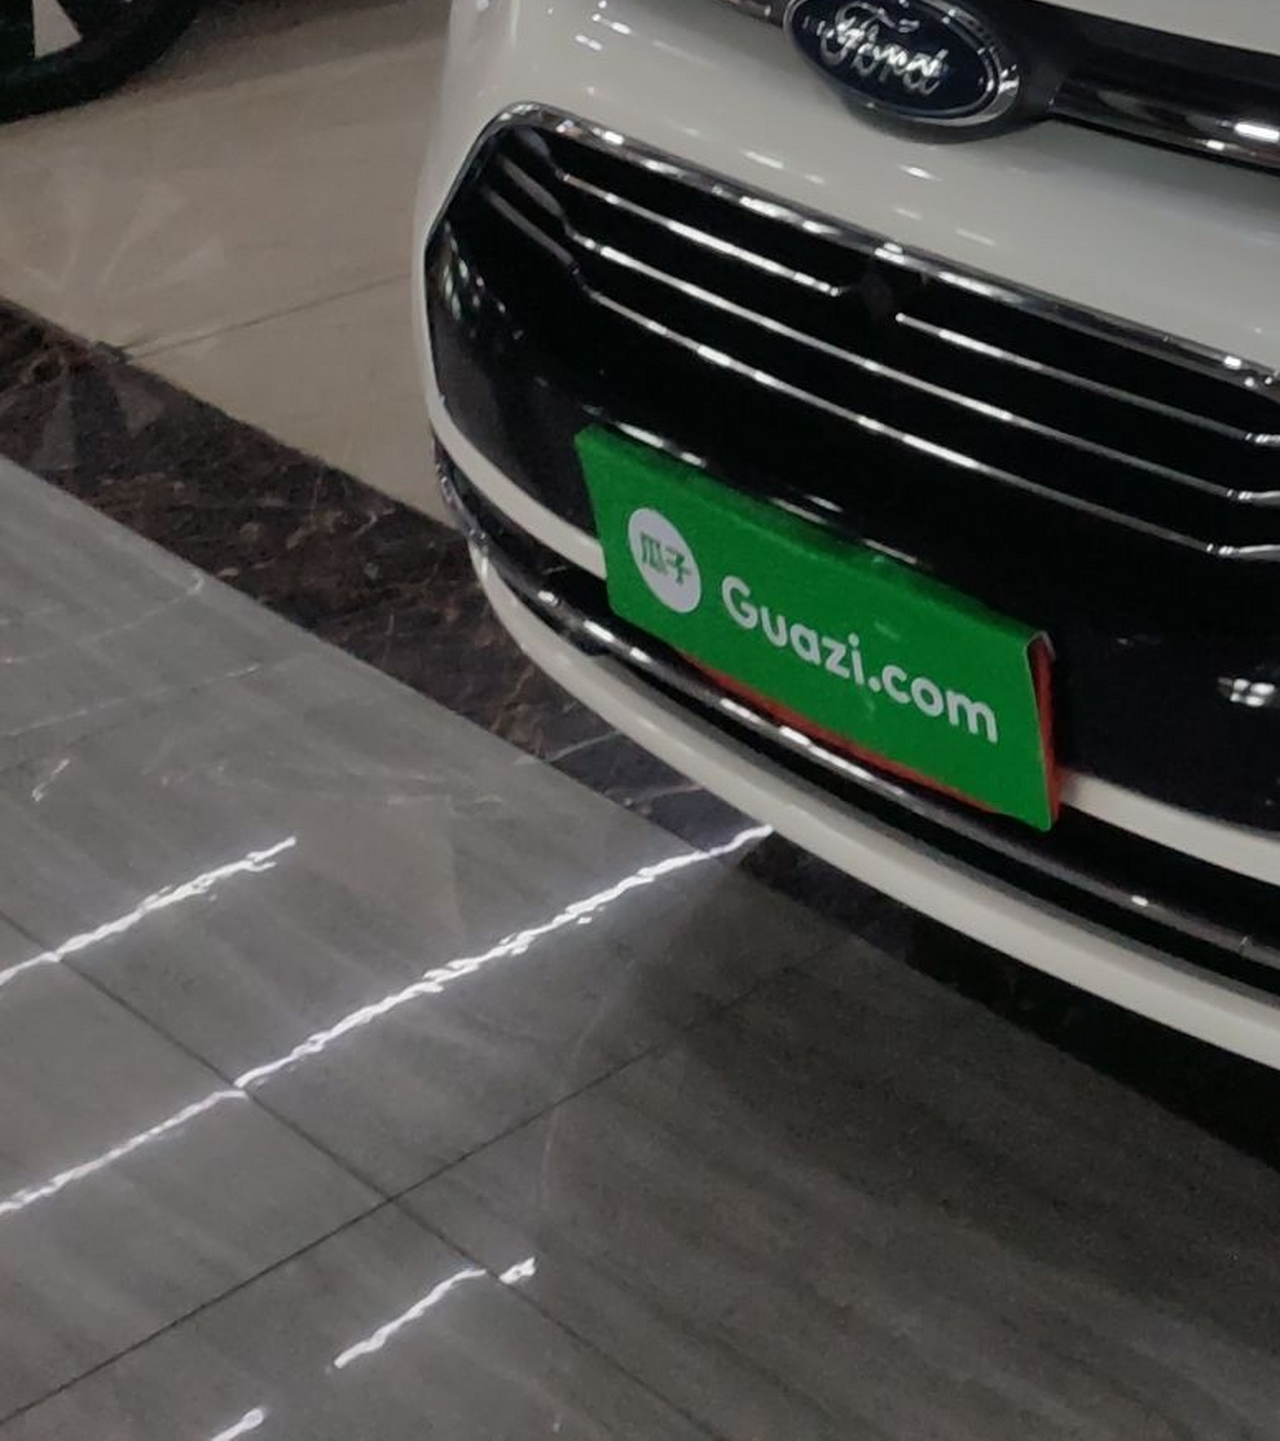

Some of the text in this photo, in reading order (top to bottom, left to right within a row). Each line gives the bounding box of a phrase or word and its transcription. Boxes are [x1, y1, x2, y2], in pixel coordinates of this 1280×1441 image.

[819, 0, 949, 96] Ford
[640, 531, 692, 585] 瓜子
[721, 574, 999, 745] Guazi.com
